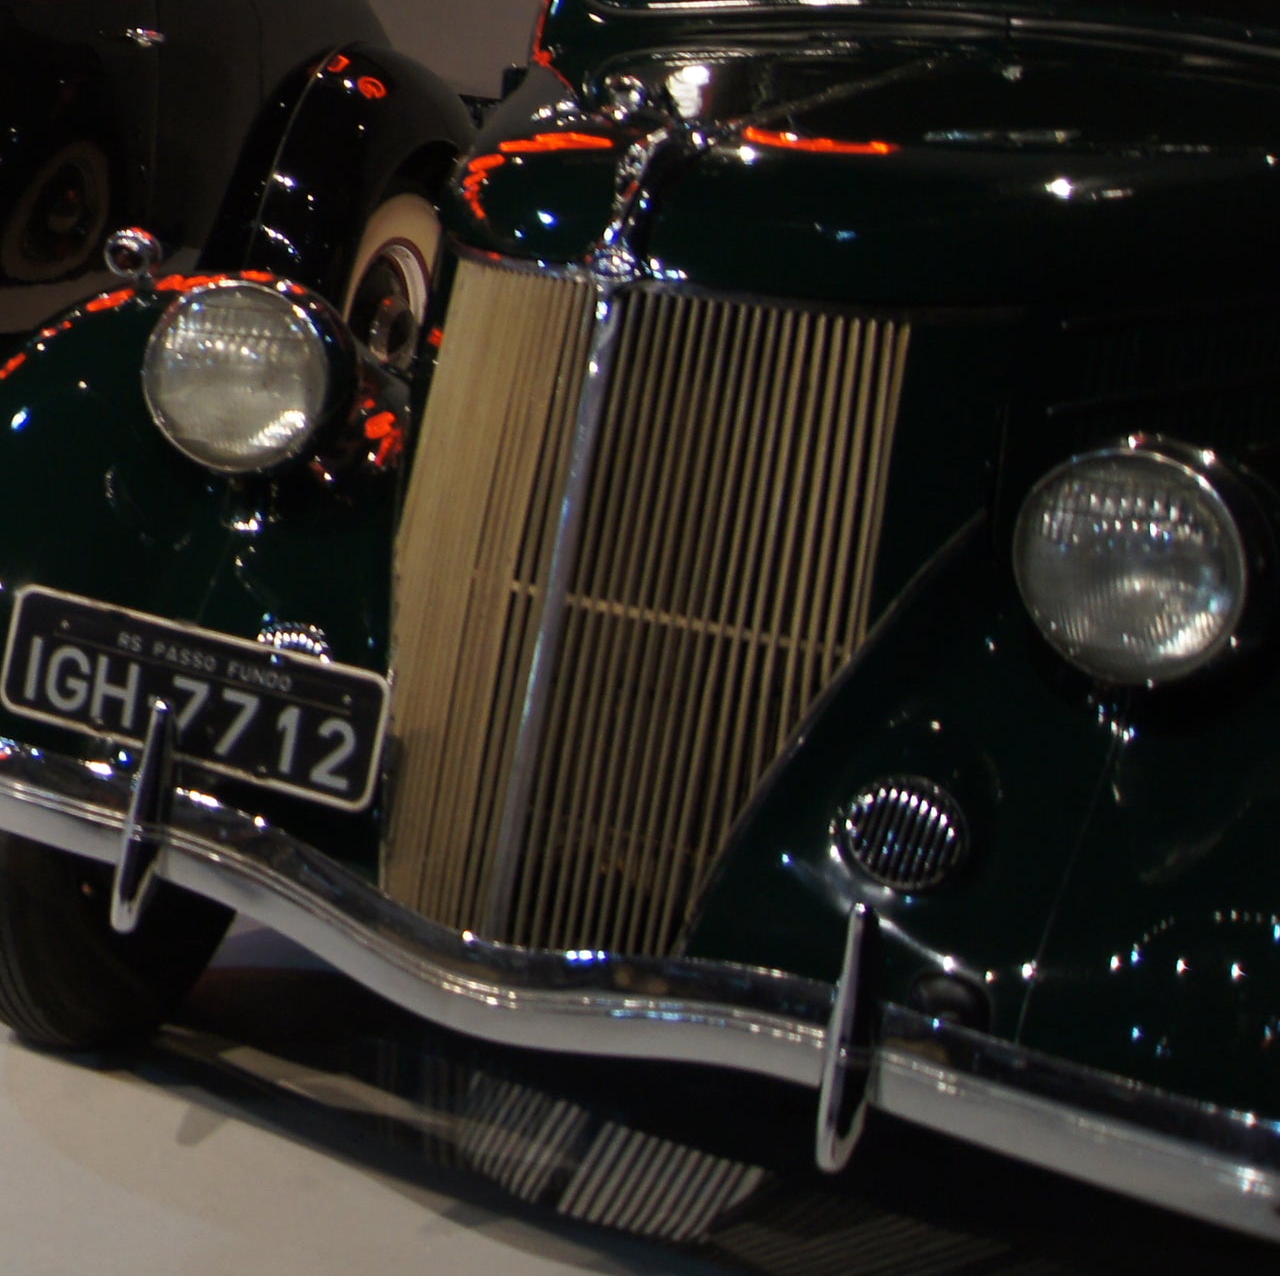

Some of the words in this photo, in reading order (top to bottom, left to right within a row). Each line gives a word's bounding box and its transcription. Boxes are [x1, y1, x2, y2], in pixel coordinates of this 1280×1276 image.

[117, 630, 142, 653] RS
[152, 640, 217, 673] PASSO
[226, 659, 293, 692] FUNDO
